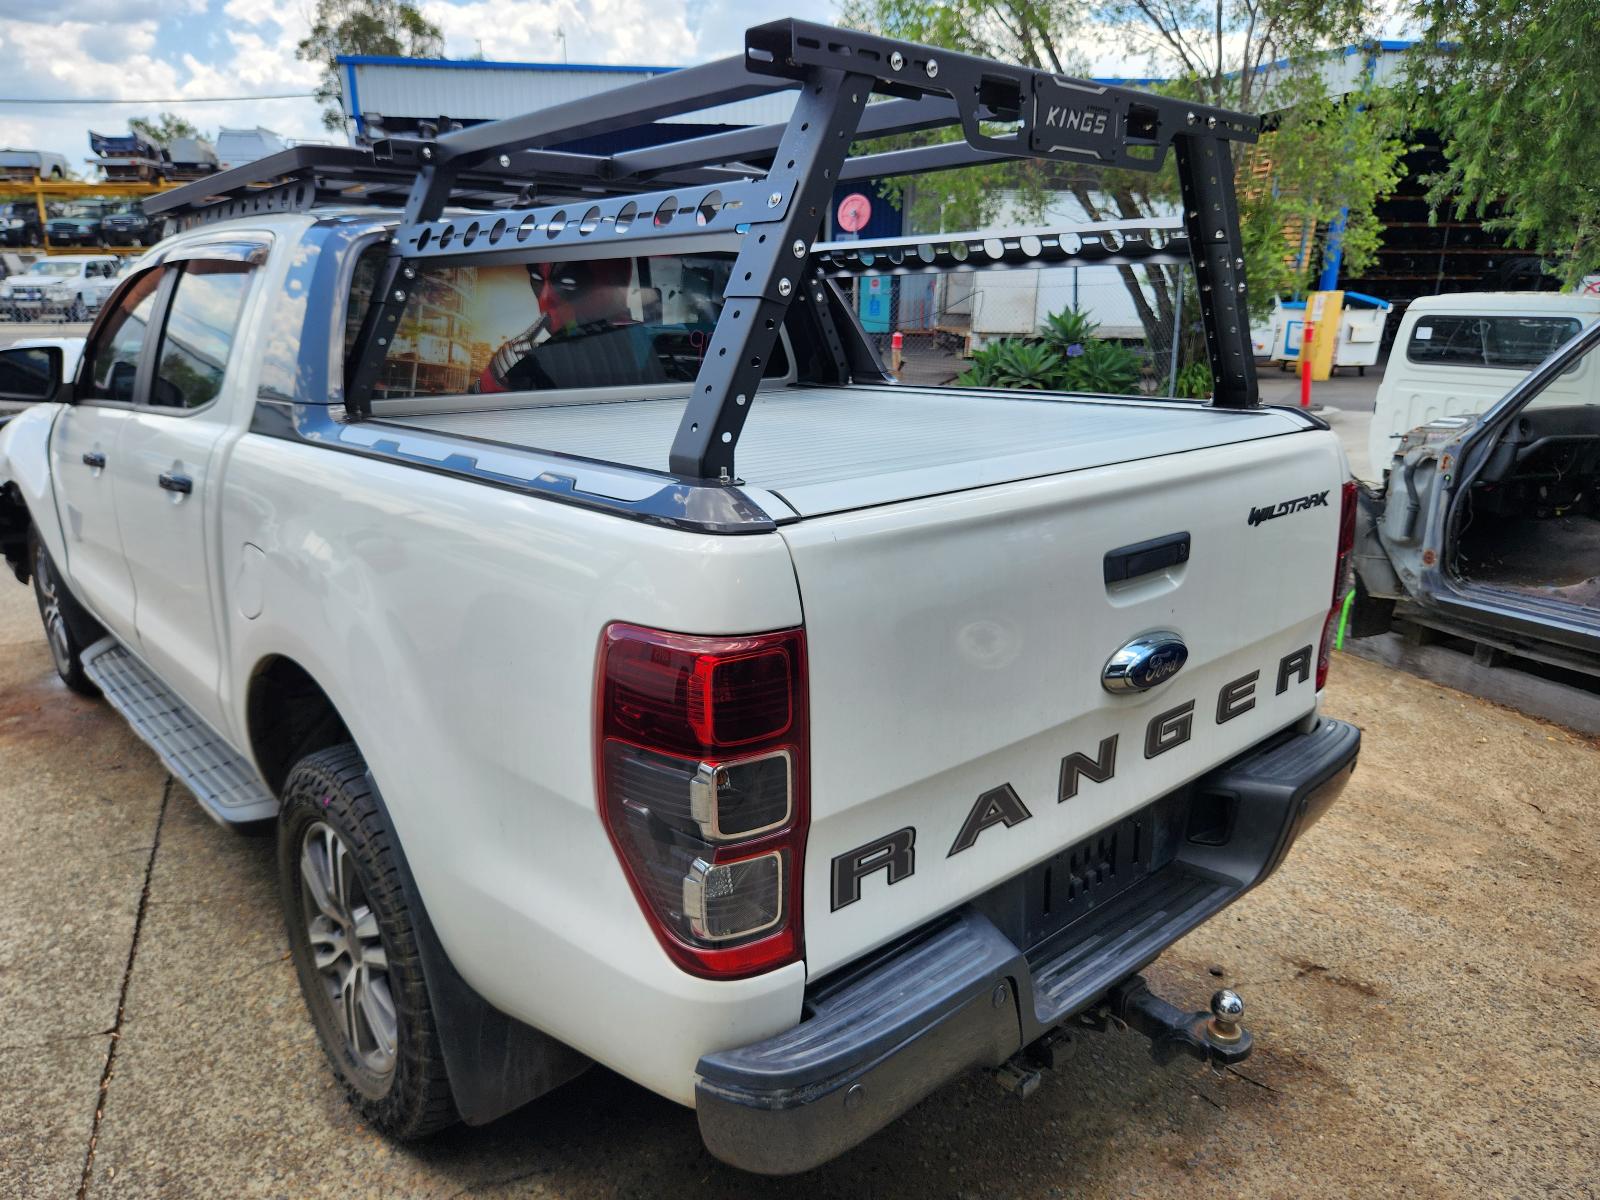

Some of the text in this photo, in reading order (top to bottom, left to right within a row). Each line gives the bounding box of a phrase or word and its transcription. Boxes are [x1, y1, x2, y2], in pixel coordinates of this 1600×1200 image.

[1046, 105, 1107, 134] KINGS
[1248, 490, 1330, 527] WILDTRAK
[1145, 650, 1181, 682] Ford
[830, 644, 1313, 913] RANGER
